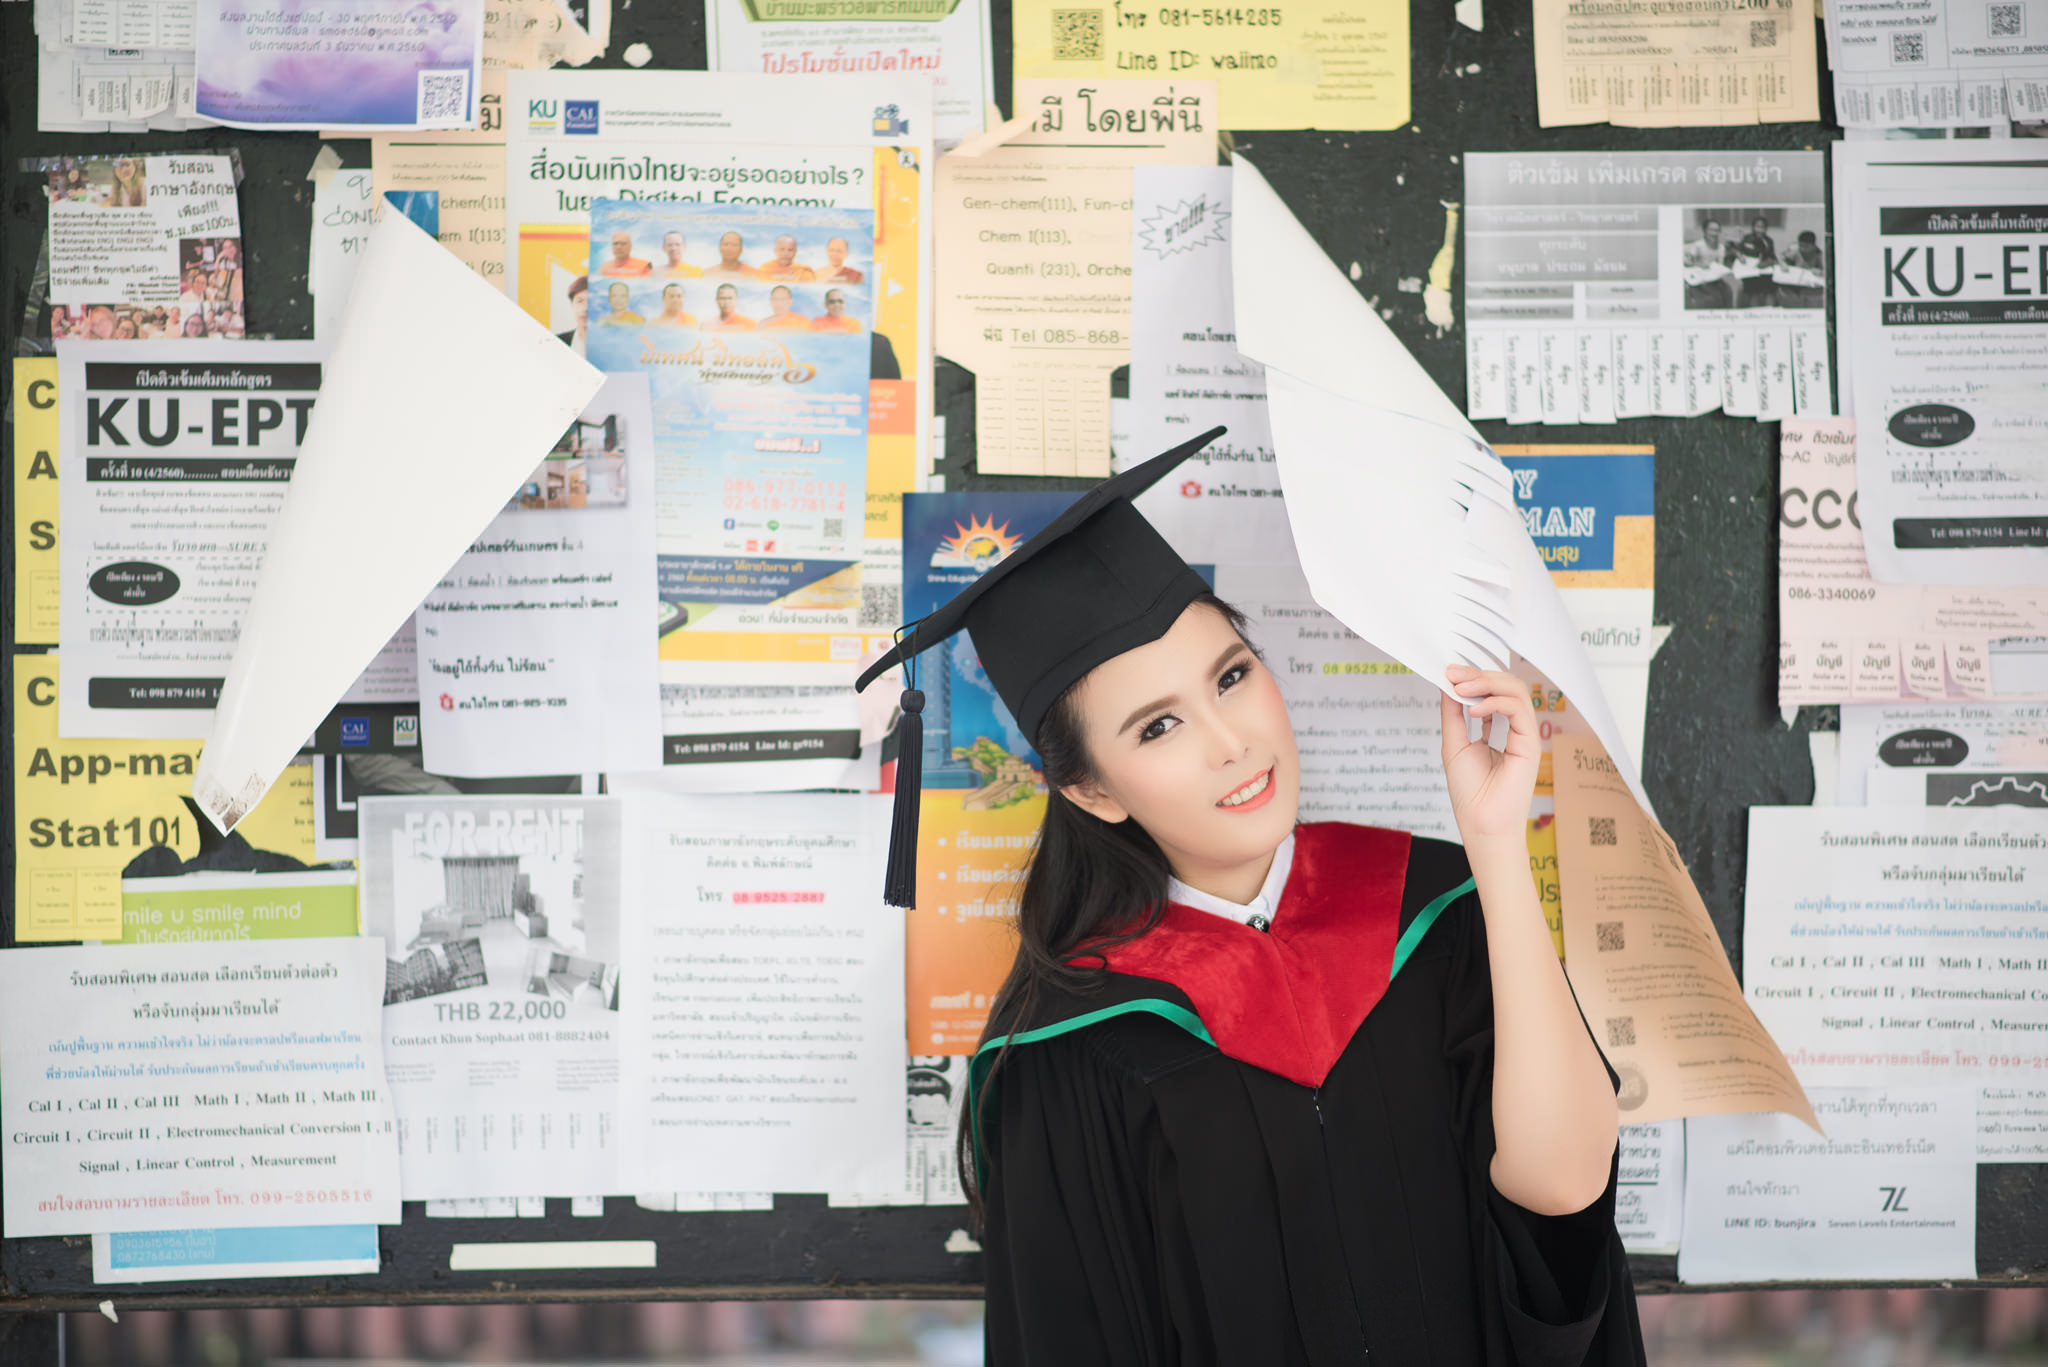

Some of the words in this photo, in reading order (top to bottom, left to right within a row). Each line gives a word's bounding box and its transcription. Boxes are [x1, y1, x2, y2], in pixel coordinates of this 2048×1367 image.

[1116, 51, 1158, 71] Line
[1168, 51, 1200, 71] ID:
[529, 99, 558, 119] KU
[1078, 86, 1203, 133] โดยพี่นี
[168, 160, 214, 175] รับสอน
[150, 179, 236, 197] ภาษาอังกฤษ
[978, 230, 1022, 244] Chem
[986, 262, 1035, 277] Quanti
[1011, 328, 1037, 344] Tel
[86, 397, 317, 448] KU-EPT
[1788, 587, 1876, 602] 086-3340069
[396, 719, 416, 732] KU
[28, 816, 182, 849] Stat101
[171, 909, 185, 924] u
[191, 903, 245, 924] smile
[252, 901, 302, 921] mind
[1771, 956, 1794, 968] Cal
[1823, 956, 1846, 968] Cal
[1880, 956, 1903, 968] Cal
[1908, 956, 1925, 968] III
[1938, 957, 1971, 970] Math
[1998, 958, 2032, 971] Math
[1754, 985, 1803, 999] Circuit
[1830, 985, 1879, 998] Circuit
[1910, 986, 2026, 1001] Electromechanical
[433, 1002, 481, 1022] THB
[488, 1001, 566, 1023] 22,000
[1821, 1016, 1864, 1031] Signal
[1880, 1016, 1921, 1030] Linear
[1926, 1018, 1975, 1031] Control
[391, 1033, 438, 1047] Contact
[440, 1032, 473, 1046] Khun
[28, 1099, 52, 1113] Cal
[78, 1098, 102, 1112] Cal
[106, 1097, 119, 1111] II
[134, 1096, 158, 1109] Cal
[162, 1095, 180, 1108] III
[193, 1093, 229, 1108] Math
[255, 1091, 291, 1106] Math
[295, 1091, 307, 1105] II
[321, 1089, 357, 1104] Math
[361, 1089, 378, 1103] III
[13, 1130, 60, 1145] Circuit
[86, 1127, 134, 1142] Circuit
[139, 1127, 151, 1141] II
[165, 1122, 286, 1140] Electromechanical
[289, 1120, 362, 1136] Conversion
[79, 1159, 120, 1176] Signal
[135, 1156, 180, 1172] Linear
[184, 1155, 236, 1171] Control
[250, 1153, 338, 1169] Measurement
[1724, 1217, 1751, 1229] LINE
[1753, 1217, 1772, 1229] ID:
[1773, 1217, 1817, 1232] bunjira
[1827, 1219, 1857, 1230] Seven
[1858, 1218, 1889, 1229] Levels
[1889, 1218, 1957, 1229] Entertainment
